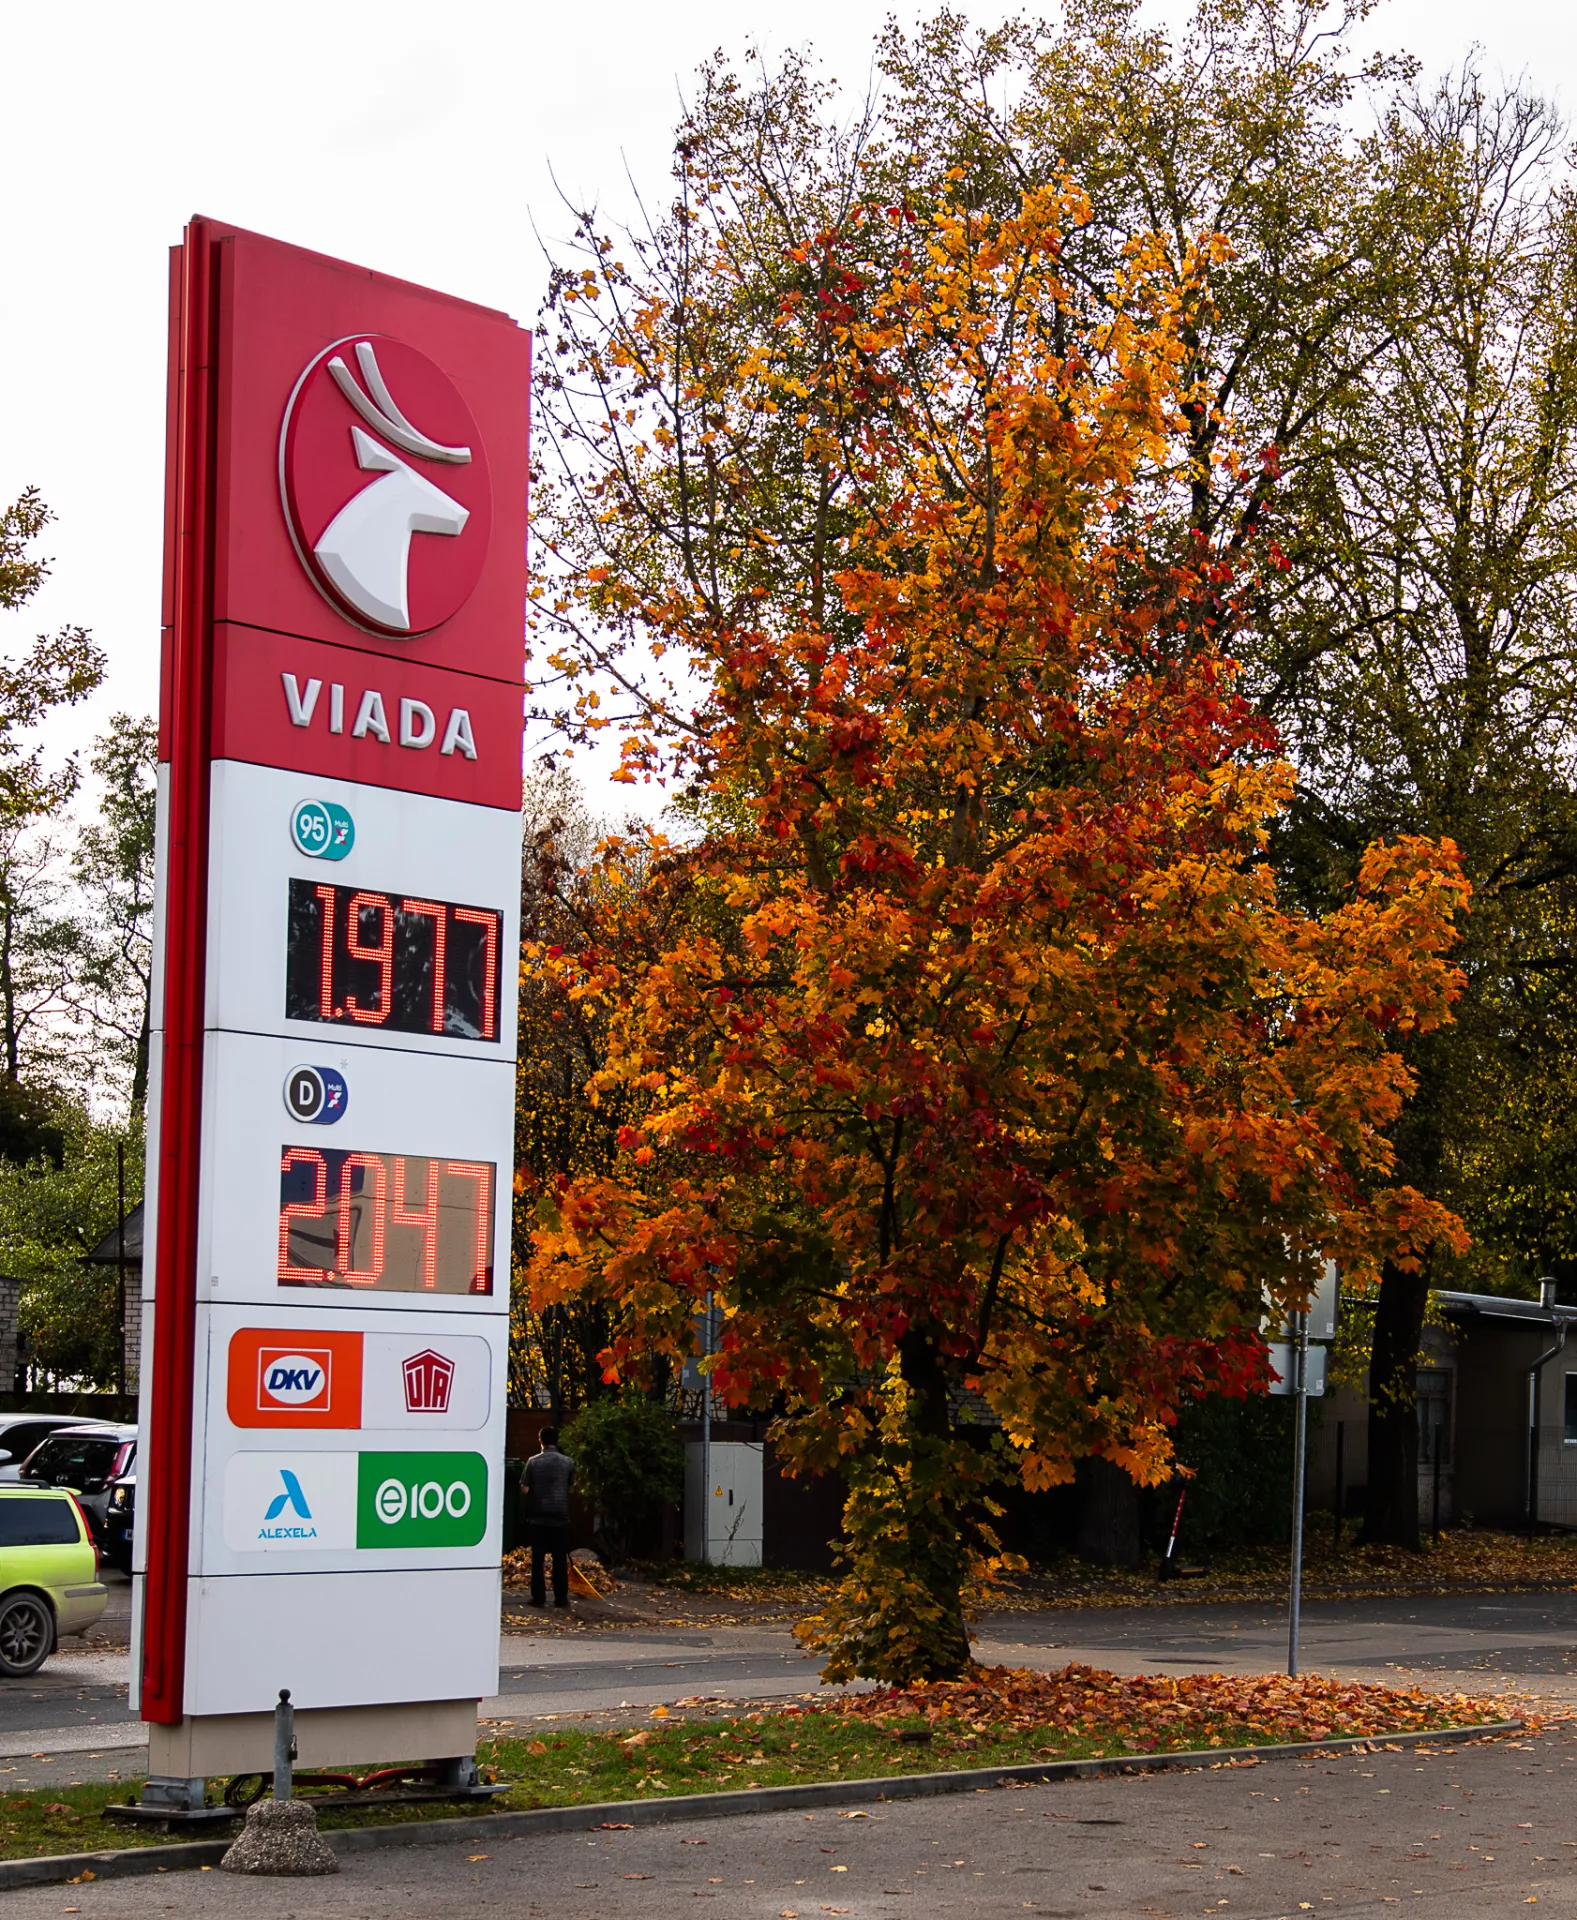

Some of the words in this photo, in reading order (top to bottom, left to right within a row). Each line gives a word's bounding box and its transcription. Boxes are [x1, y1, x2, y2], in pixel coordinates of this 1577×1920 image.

[281, 672, 478, 761] VIADA
[299, 813, 325, 842] 95
[315, 885, 498, 1039] 1.977
[299, 1080, 315, 1106] D
[277, 1147, 491, 1291] 2.047
[268, 1368, 321, 1390] DKV
[404, 1352, 453, 1410] UTA
[375, 1478, 471, 1525] e100
[258, 1527, 317, 1539] ALEXELA
